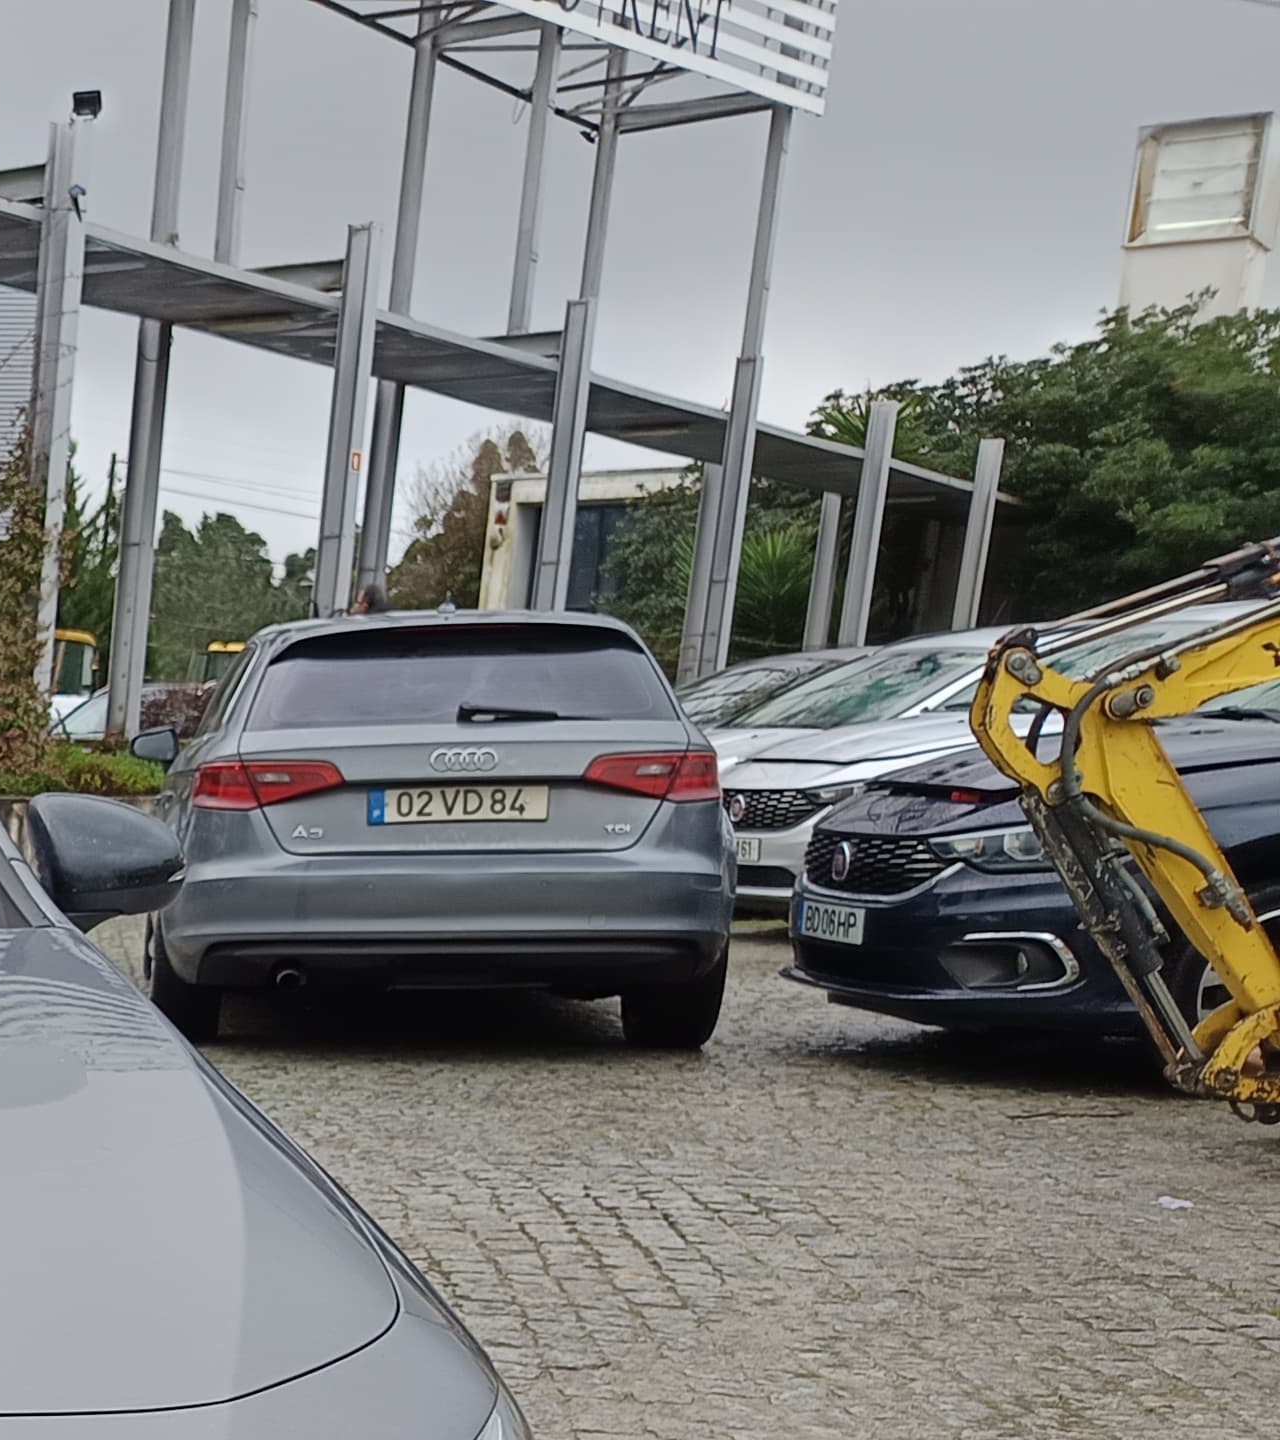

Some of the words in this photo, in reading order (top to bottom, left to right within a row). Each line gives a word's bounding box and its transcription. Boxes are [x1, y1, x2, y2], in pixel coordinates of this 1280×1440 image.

[396, 790, 434, 818] 02
[440, 788, 484, 816] VD
[490, 788, 527, 816] 84
[603, 823, 631, 834] TDI
[804, 905, 820, 933] BD
[821, 908, 836, 937] 06
[836, 911, 857, 940] HP
